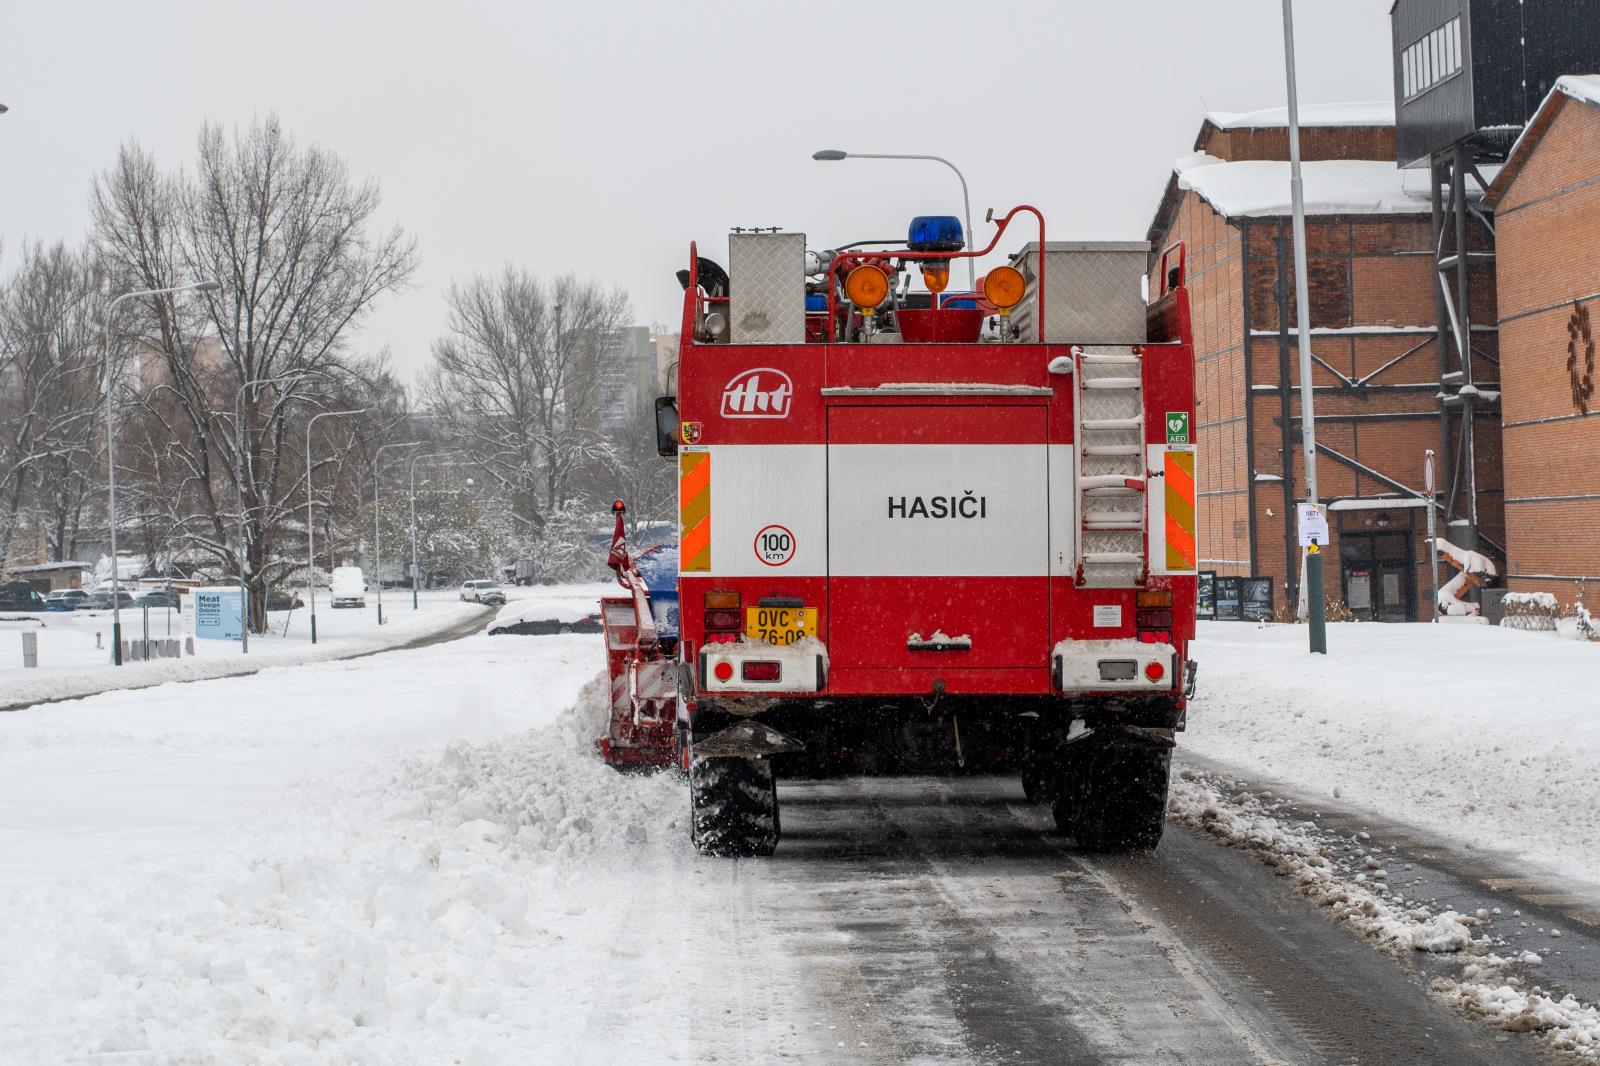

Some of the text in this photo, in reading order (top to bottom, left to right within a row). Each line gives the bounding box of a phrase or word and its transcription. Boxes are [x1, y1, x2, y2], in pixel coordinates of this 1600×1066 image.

[729, 375, 786, 412] tht
[888, 490, 986, 518] HASIČI
[761, 534, 790, 551] 100
[765, 552, 784, 560] km
[758, 610, 789, 627] OVC
